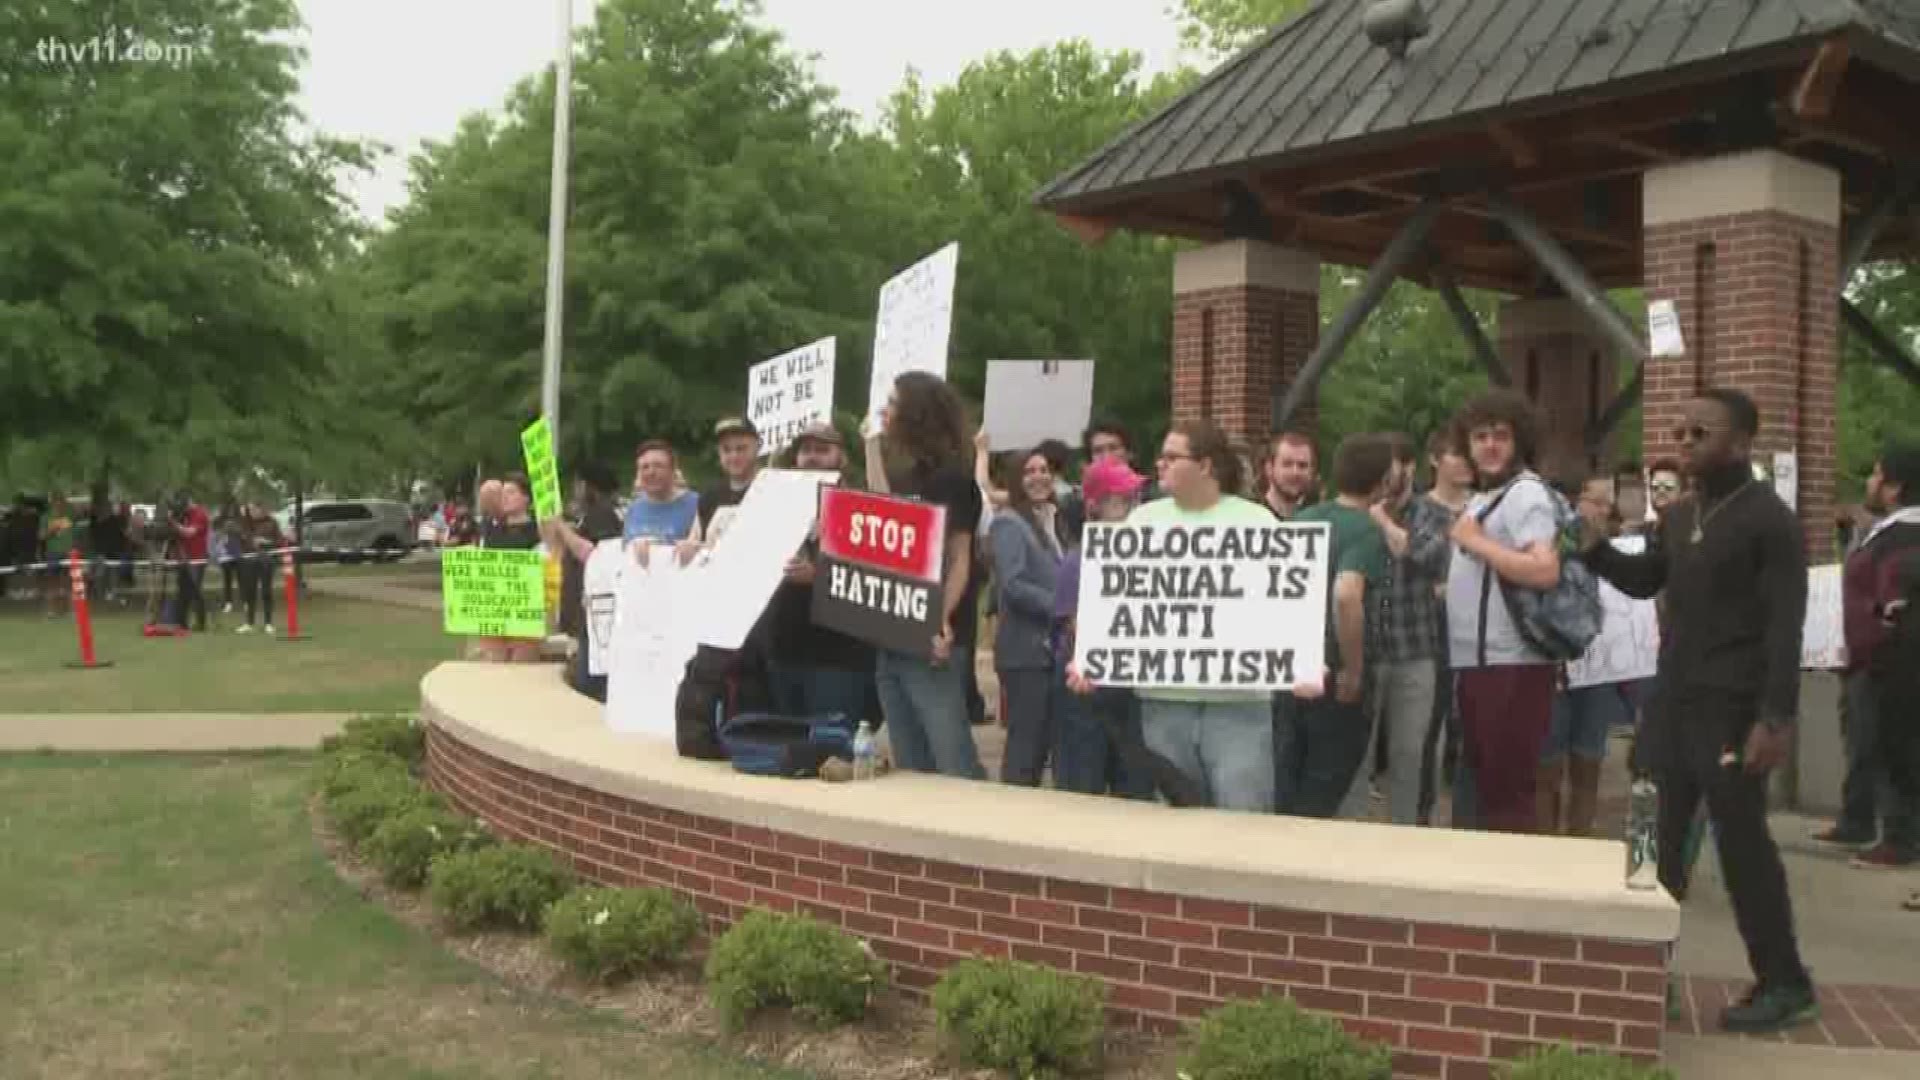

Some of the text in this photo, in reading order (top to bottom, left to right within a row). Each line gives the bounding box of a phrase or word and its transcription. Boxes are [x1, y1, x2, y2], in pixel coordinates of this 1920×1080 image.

[760, 347, 824, 385] WE WILL
[754, 379, 814, 420] NOT BE
[850, 512, 916, 558] STOP
[1086, 526, 1324, 560] HOLOCAUST
[456, 551, 498, 562] MILLION
[478, 565, 520, 577] KILLED
[506, 581, 529, 594] THE
[830, 564, 928, 621] HATING
[1101, 564, 1309, 598] DENIAL IS
[1109, 604, 1215, 637] ANTI
[1084, 648, 1295, 683] SEMITISM
